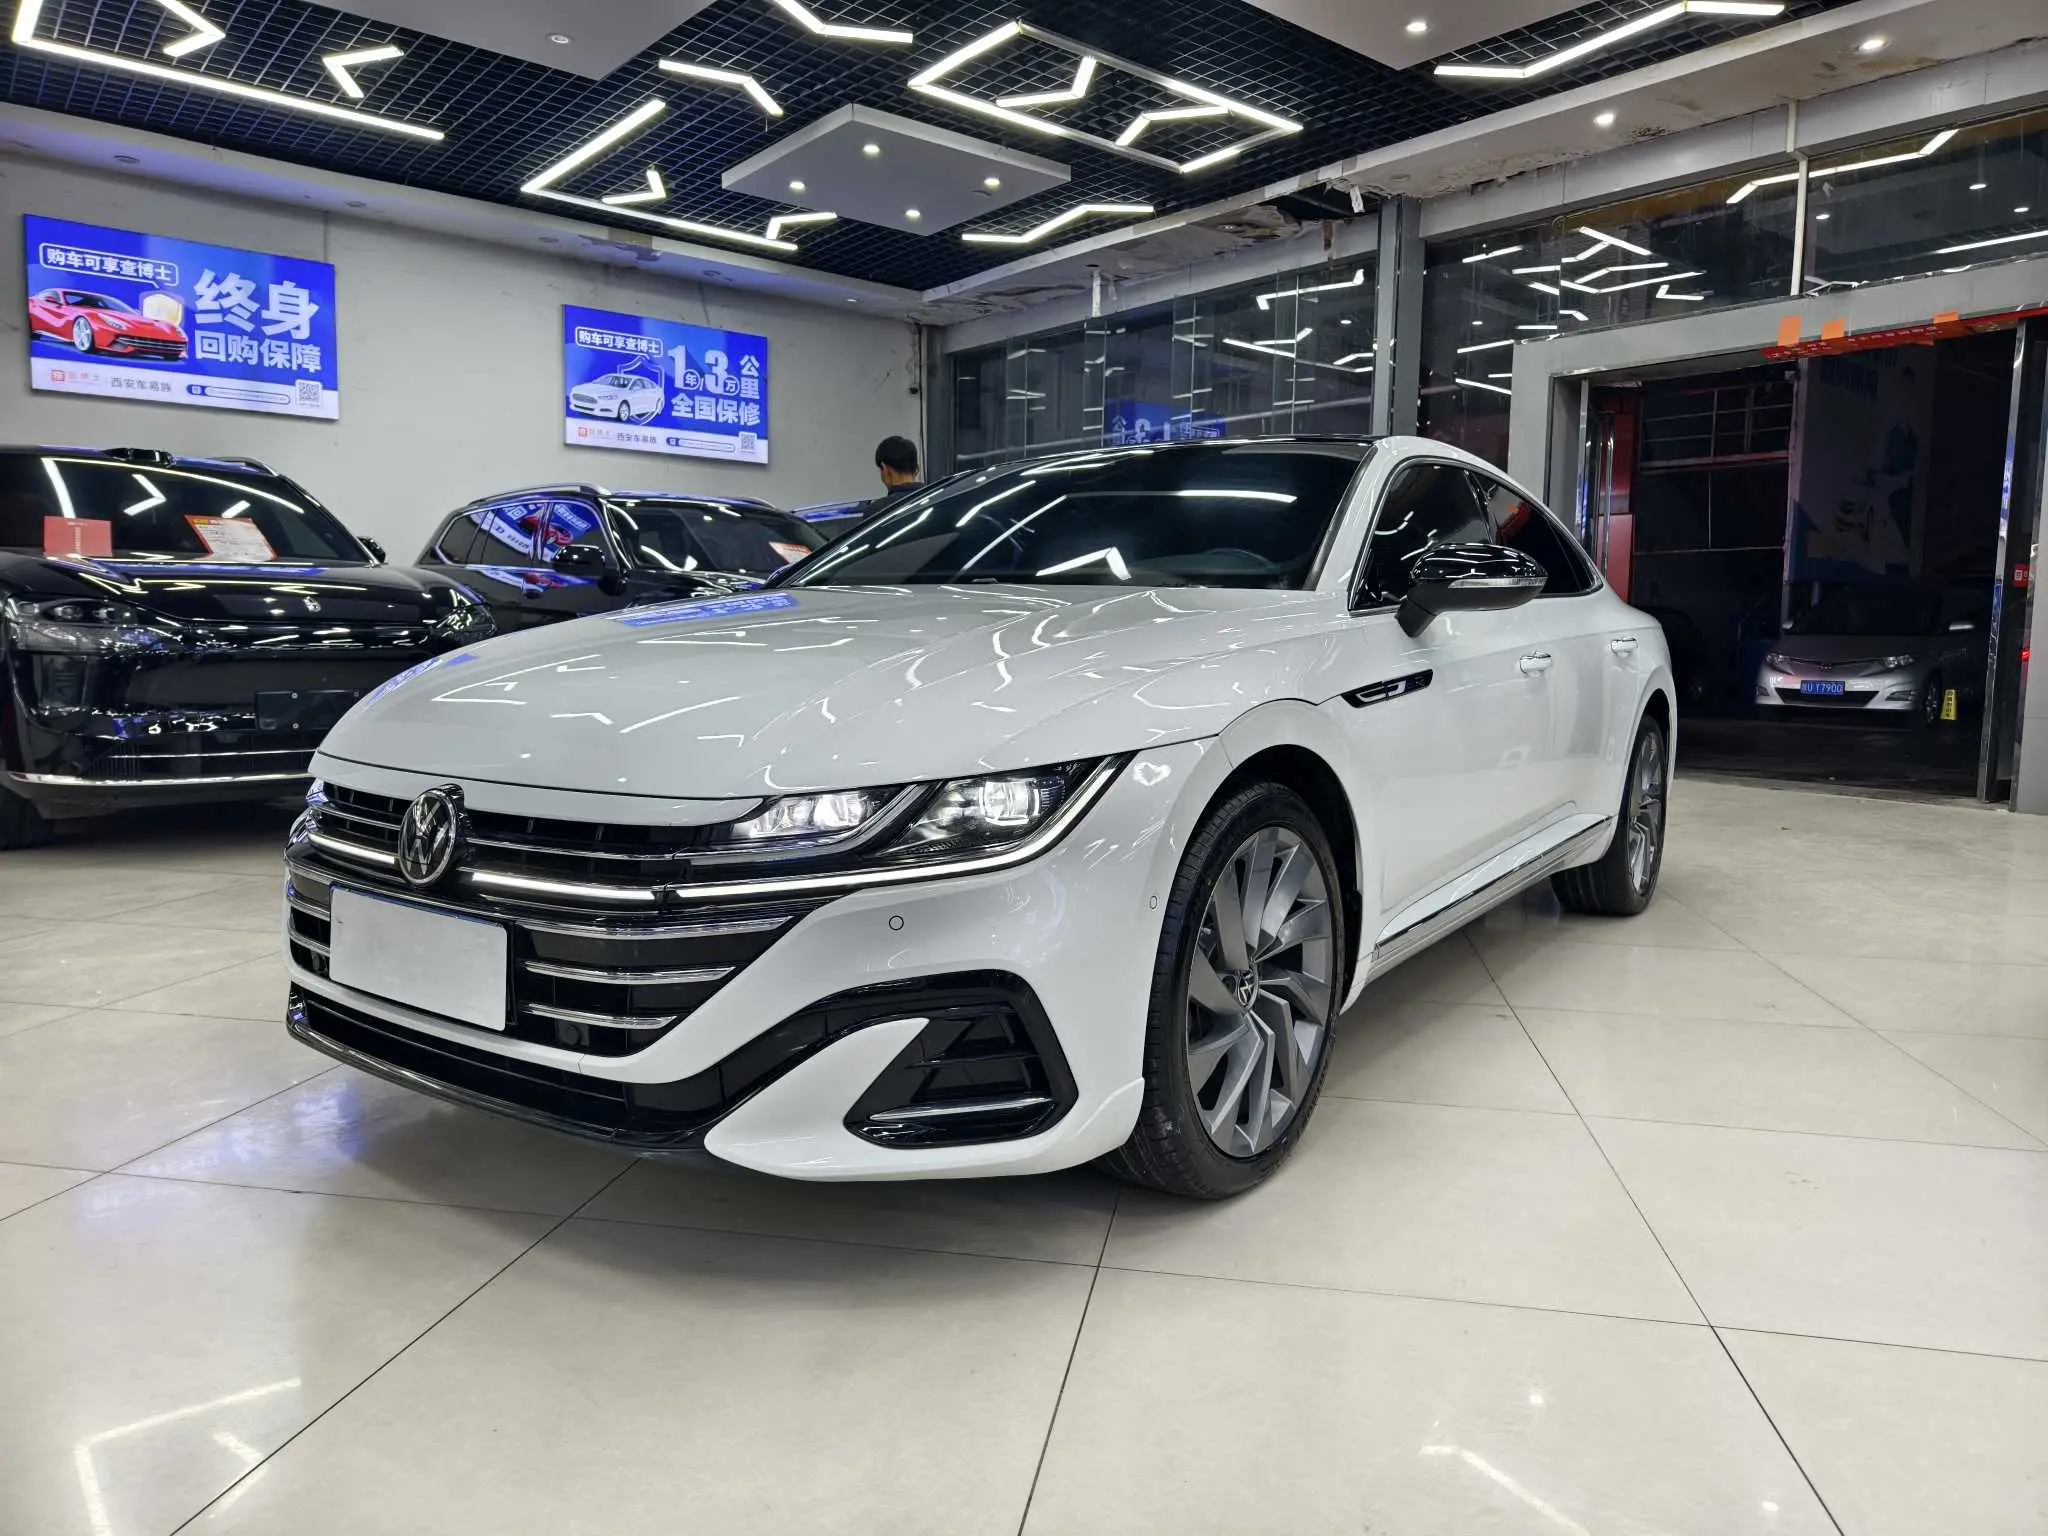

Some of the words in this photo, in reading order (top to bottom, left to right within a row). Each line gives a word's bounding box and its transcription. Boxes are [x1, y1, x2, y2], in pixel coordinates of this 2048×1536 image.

[47, 248, 173, 282] 购车可享查博士
[193, 268, 320, 341] 终身
[194, 330, 321, 373] 回购保障
[579, 330, 661, 354] 购车可享查博士
[671, 393, 760, 426] 全国保修
